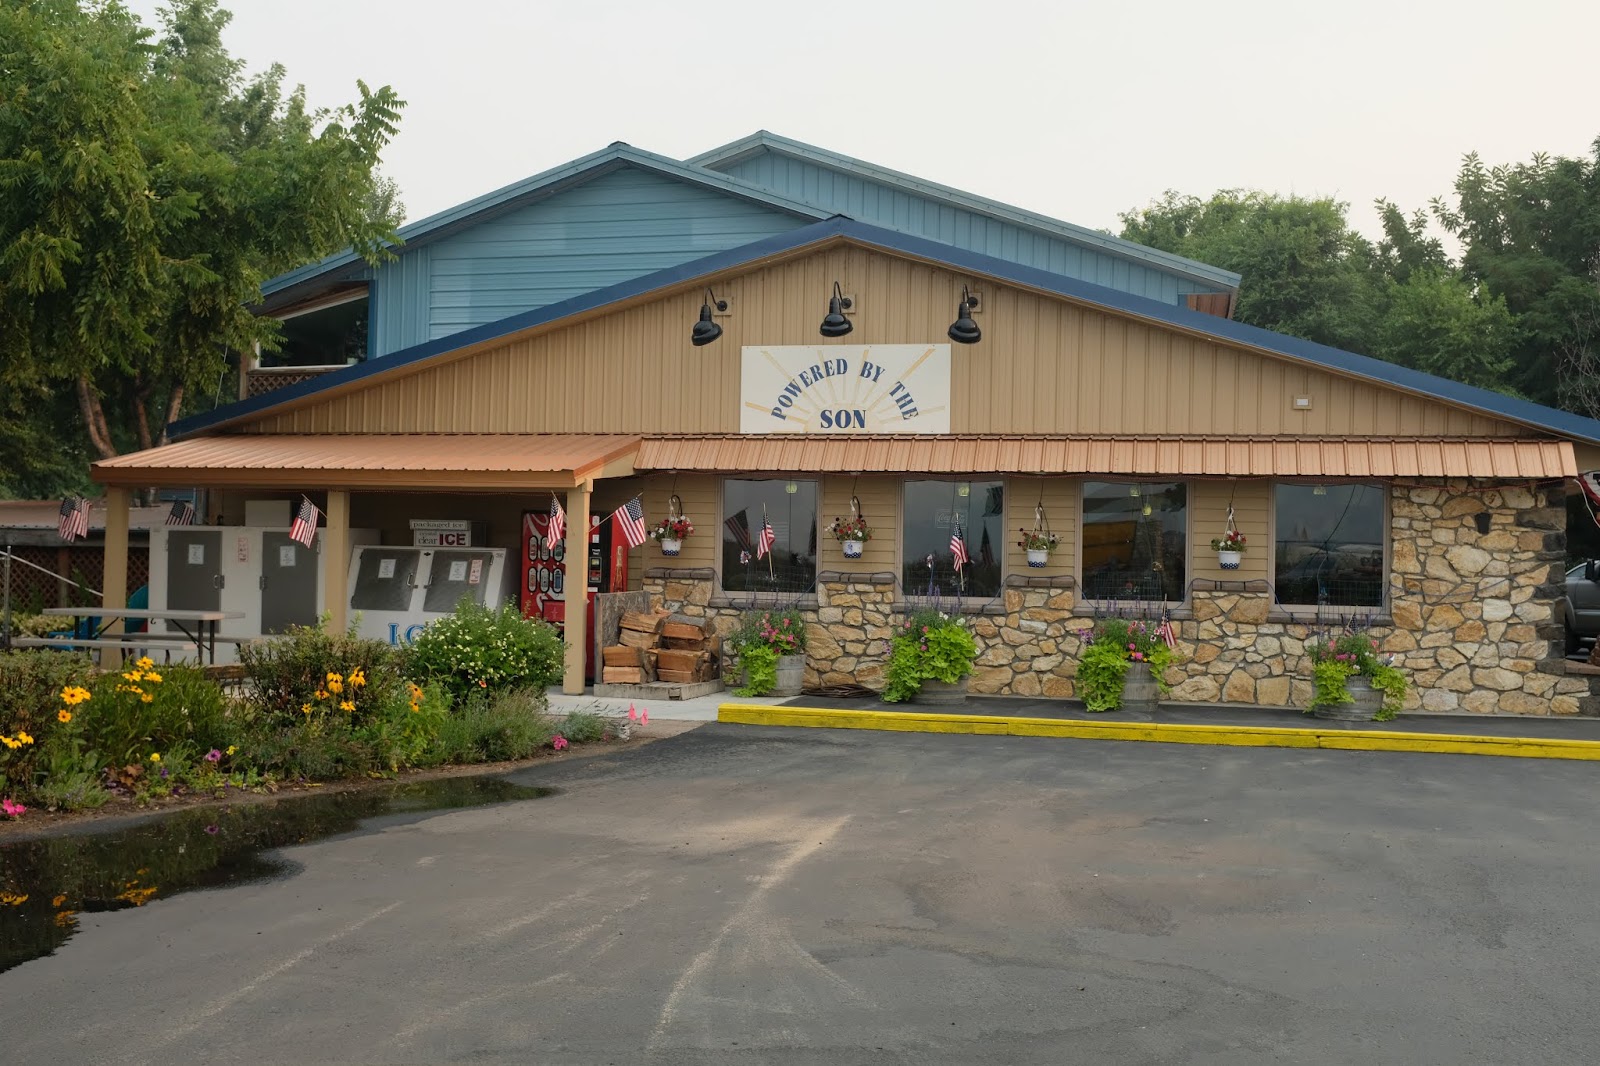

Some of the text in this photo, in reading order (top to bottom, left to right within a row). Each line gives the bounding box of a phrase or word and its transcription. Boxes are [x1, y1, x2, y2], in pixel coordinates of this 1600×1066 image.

[771, 358, 919, 421] POWERED BY THE
[820, 409, 867, 429] SON
[418, 533, 467, 546] clear ICE
[388, 623, 426, 648] IC
